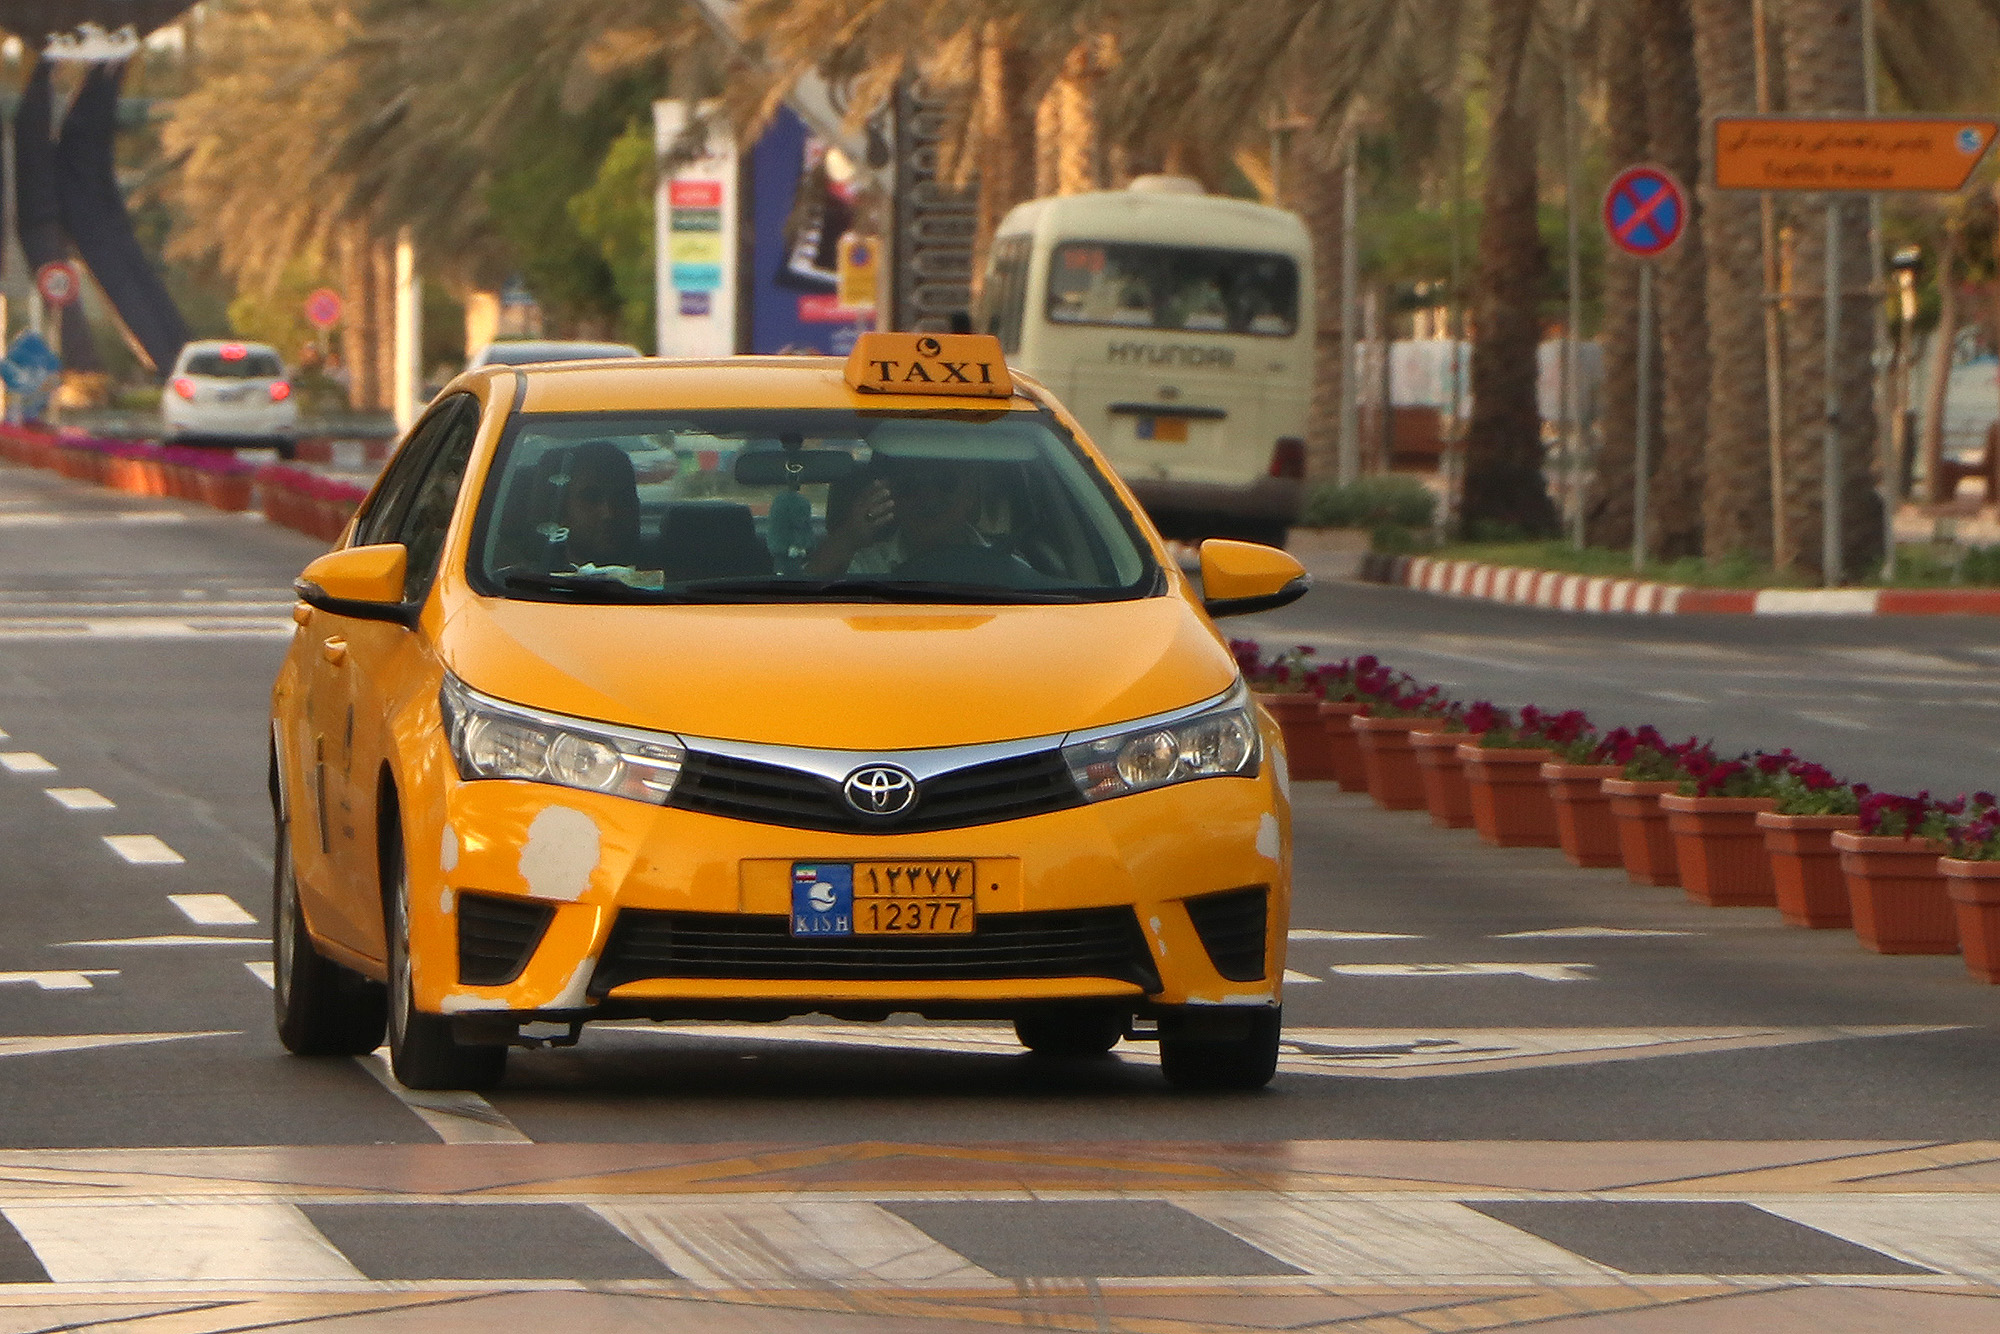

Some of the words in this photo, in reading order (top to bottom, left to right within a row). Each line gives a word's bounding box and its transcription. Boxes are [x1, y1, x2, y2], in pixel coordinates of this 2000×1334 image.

[1107, 341, 1235, 368] HYUNDAI
[870, 360, 994, 384] TAXI
[796, 915, 849, 933] KISH
[869, 903, 961, 931] 12377
